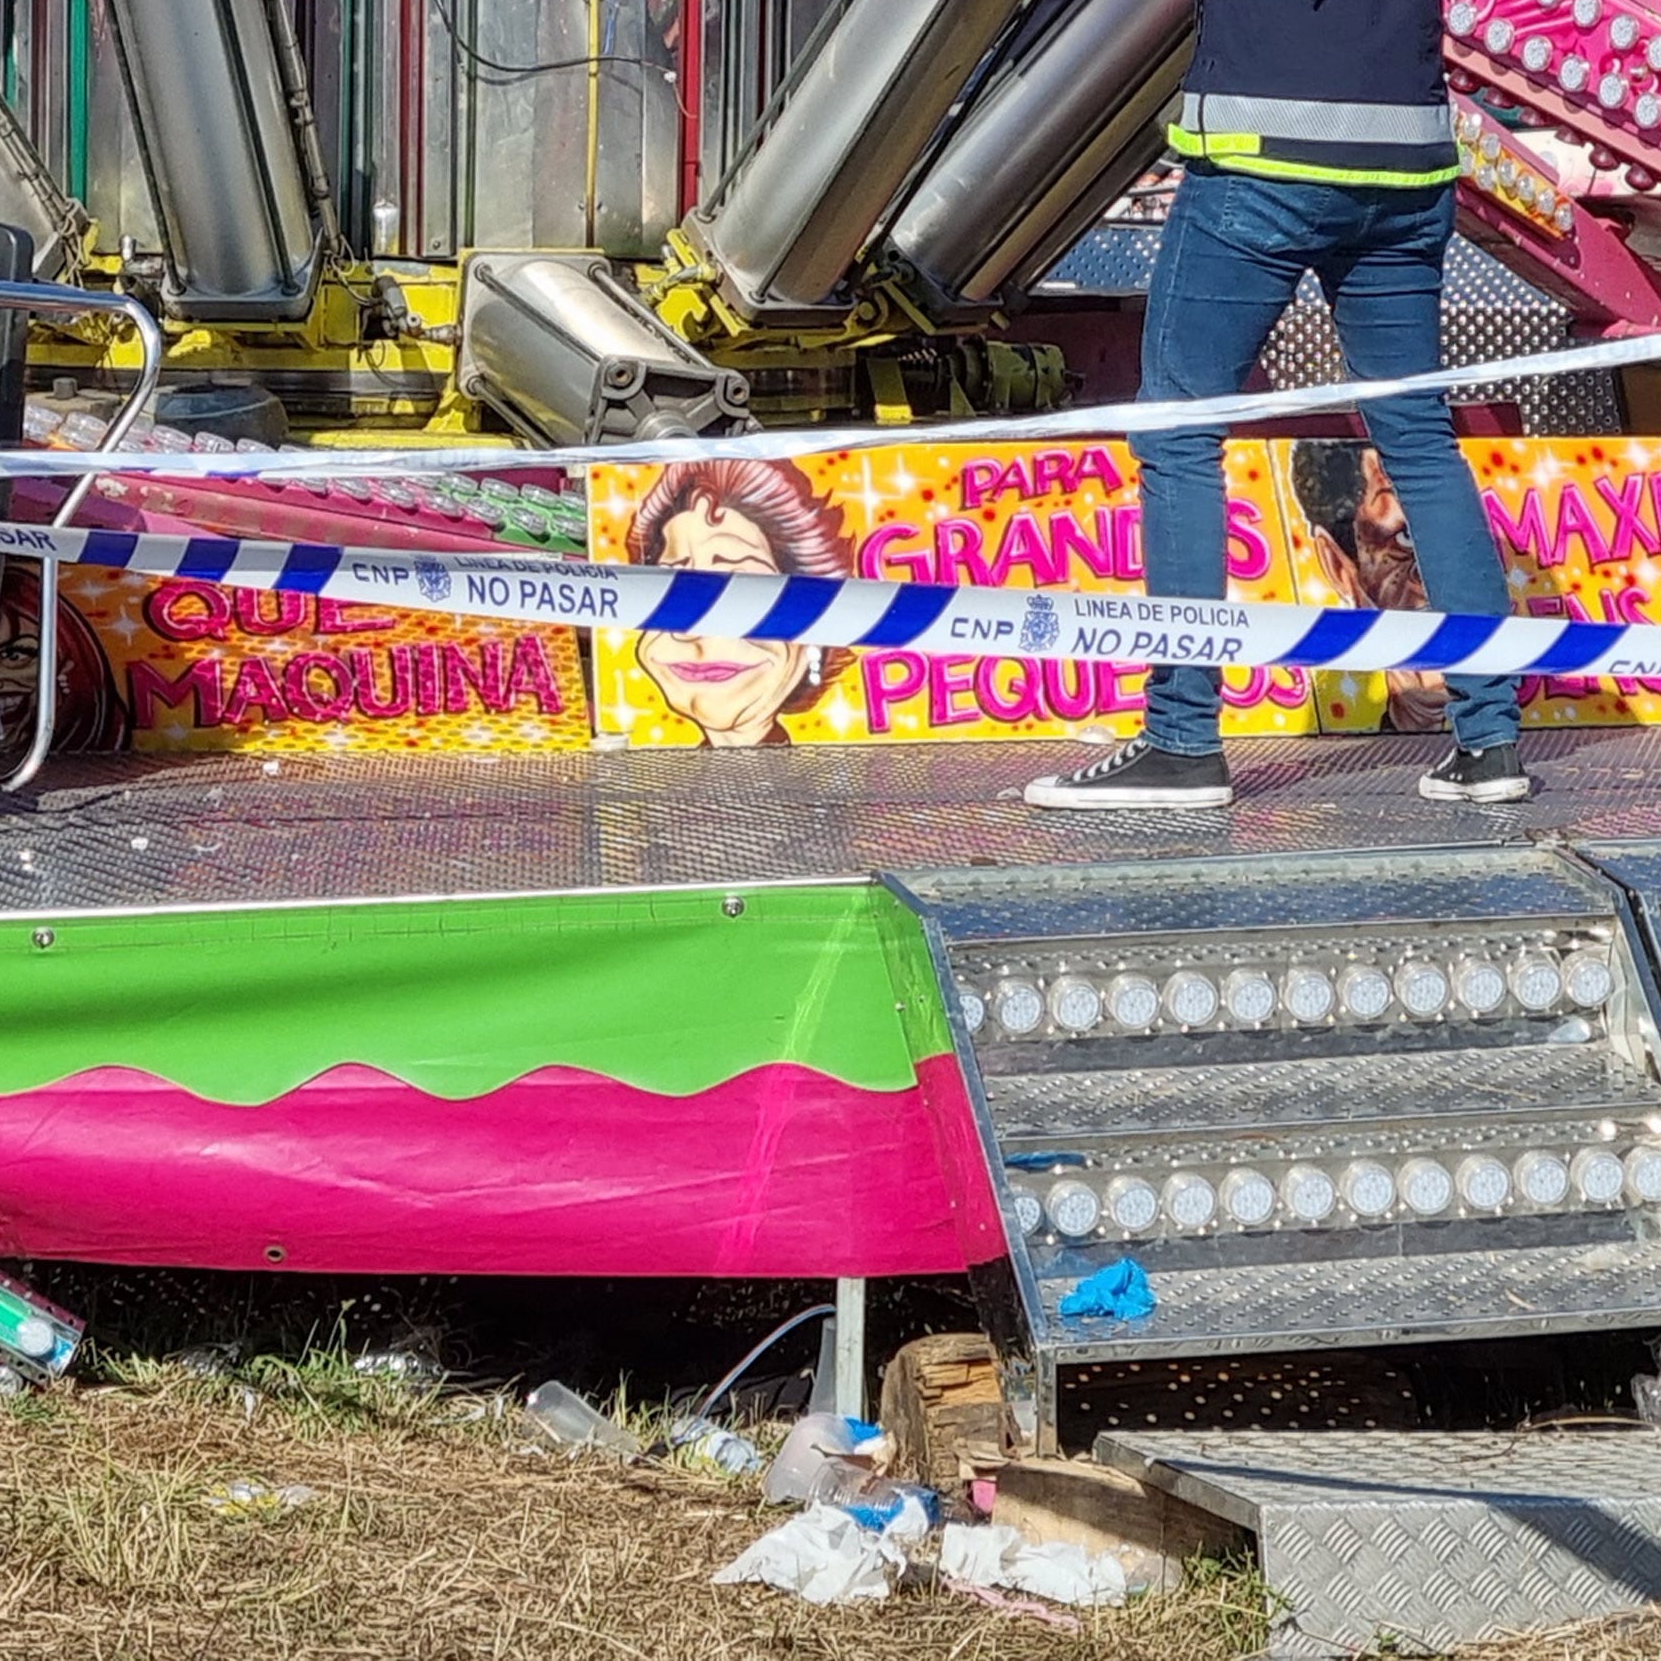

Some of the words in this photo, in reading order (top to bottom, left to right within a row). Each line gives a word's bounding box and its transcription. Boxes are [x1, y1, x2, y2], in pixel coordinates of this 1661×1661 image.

[961, 445, 1123, 510] PARA
[858, 498, 1272, 590] GRANDS
[352, 561, 410, 586] CNP
[514, 558, 541, 573] DE
[542, 562, 619, 581] POLICIA
[467, 574, 510, 607] NO
[519, 579, 619, 619] PASAR
[1074, 598, 1133, 620] LINEA
[1138, 602, 1164, 622] DE
[1170, 605, 1250, 628] POLICIA
[950, 617, 1015, 641] CNP
[1071, 627, 1122, 656] NO
[1129, 630, 1243, 662] PASAR
[127, 633, 565, 730] MAQUINA
